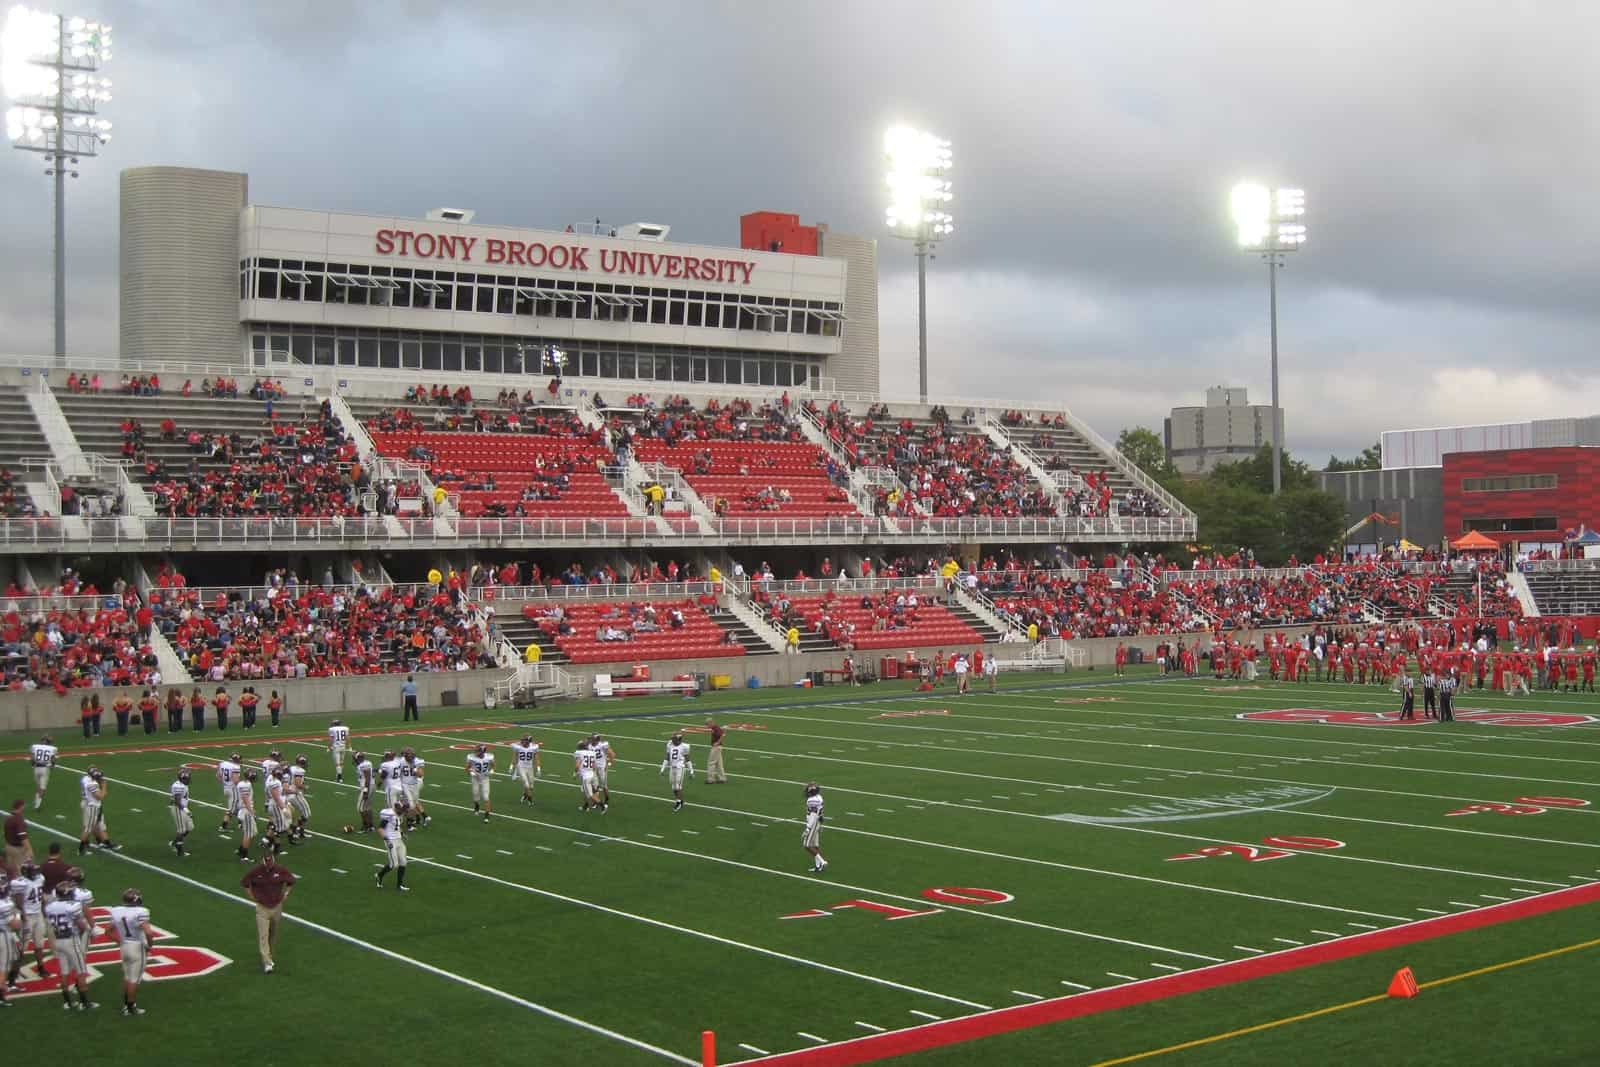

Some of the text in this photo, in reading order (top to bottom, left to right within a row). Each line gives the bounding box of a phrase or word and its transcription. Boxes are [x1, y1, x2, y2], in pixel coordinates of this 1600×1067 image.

[375, 229, 756, 285] STONY BROOK UNIVERSITY
[335, 730, 347, 742] 18
[35, 748, 50, 762] 86
[1469, 796, 1591, 816] 30
[1197, 834, 1347, 863] 20
[826, 886, 1016, 921] 10
